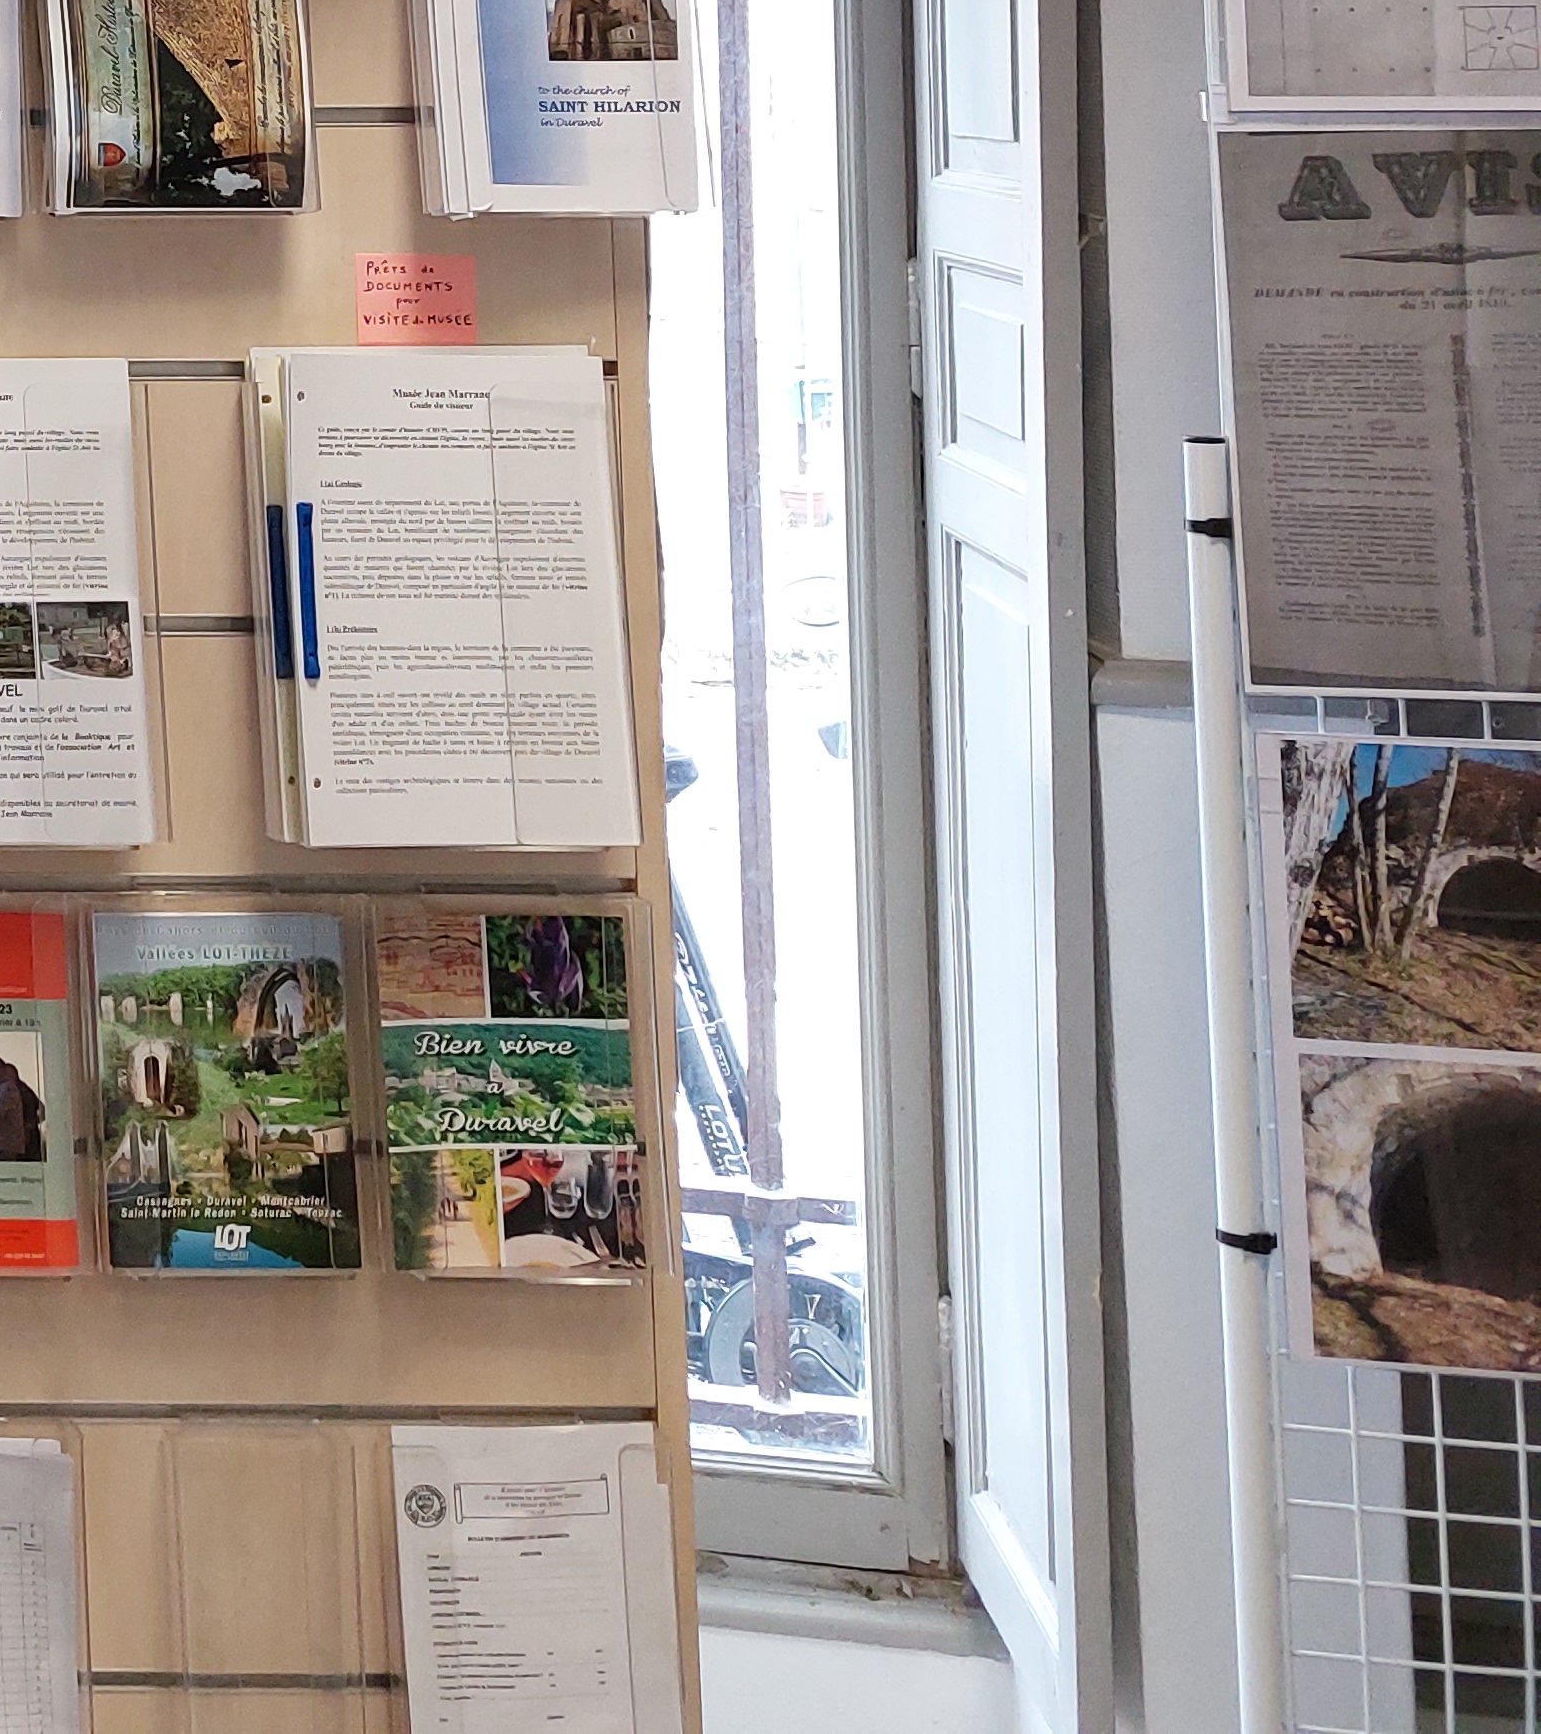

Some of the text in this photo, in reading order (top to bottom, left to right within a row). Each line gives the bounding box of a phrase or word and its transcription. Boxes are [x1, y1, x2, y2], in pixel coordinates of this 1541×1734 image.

[538, 85, 631, 97] to the church of
[538, 100, 681, 113] SAINT HILARION
[541, 117, 604, 127] in Duravel
[1277, 149, 1541, 220] AVI
[363, 281, 453, 292] DOCUMENTS
[414, 1031, 577, 1056] Bien vivre
[438, 1107, 564, 1133] Duravel
[214, 1223, 252, 1251] LOT
